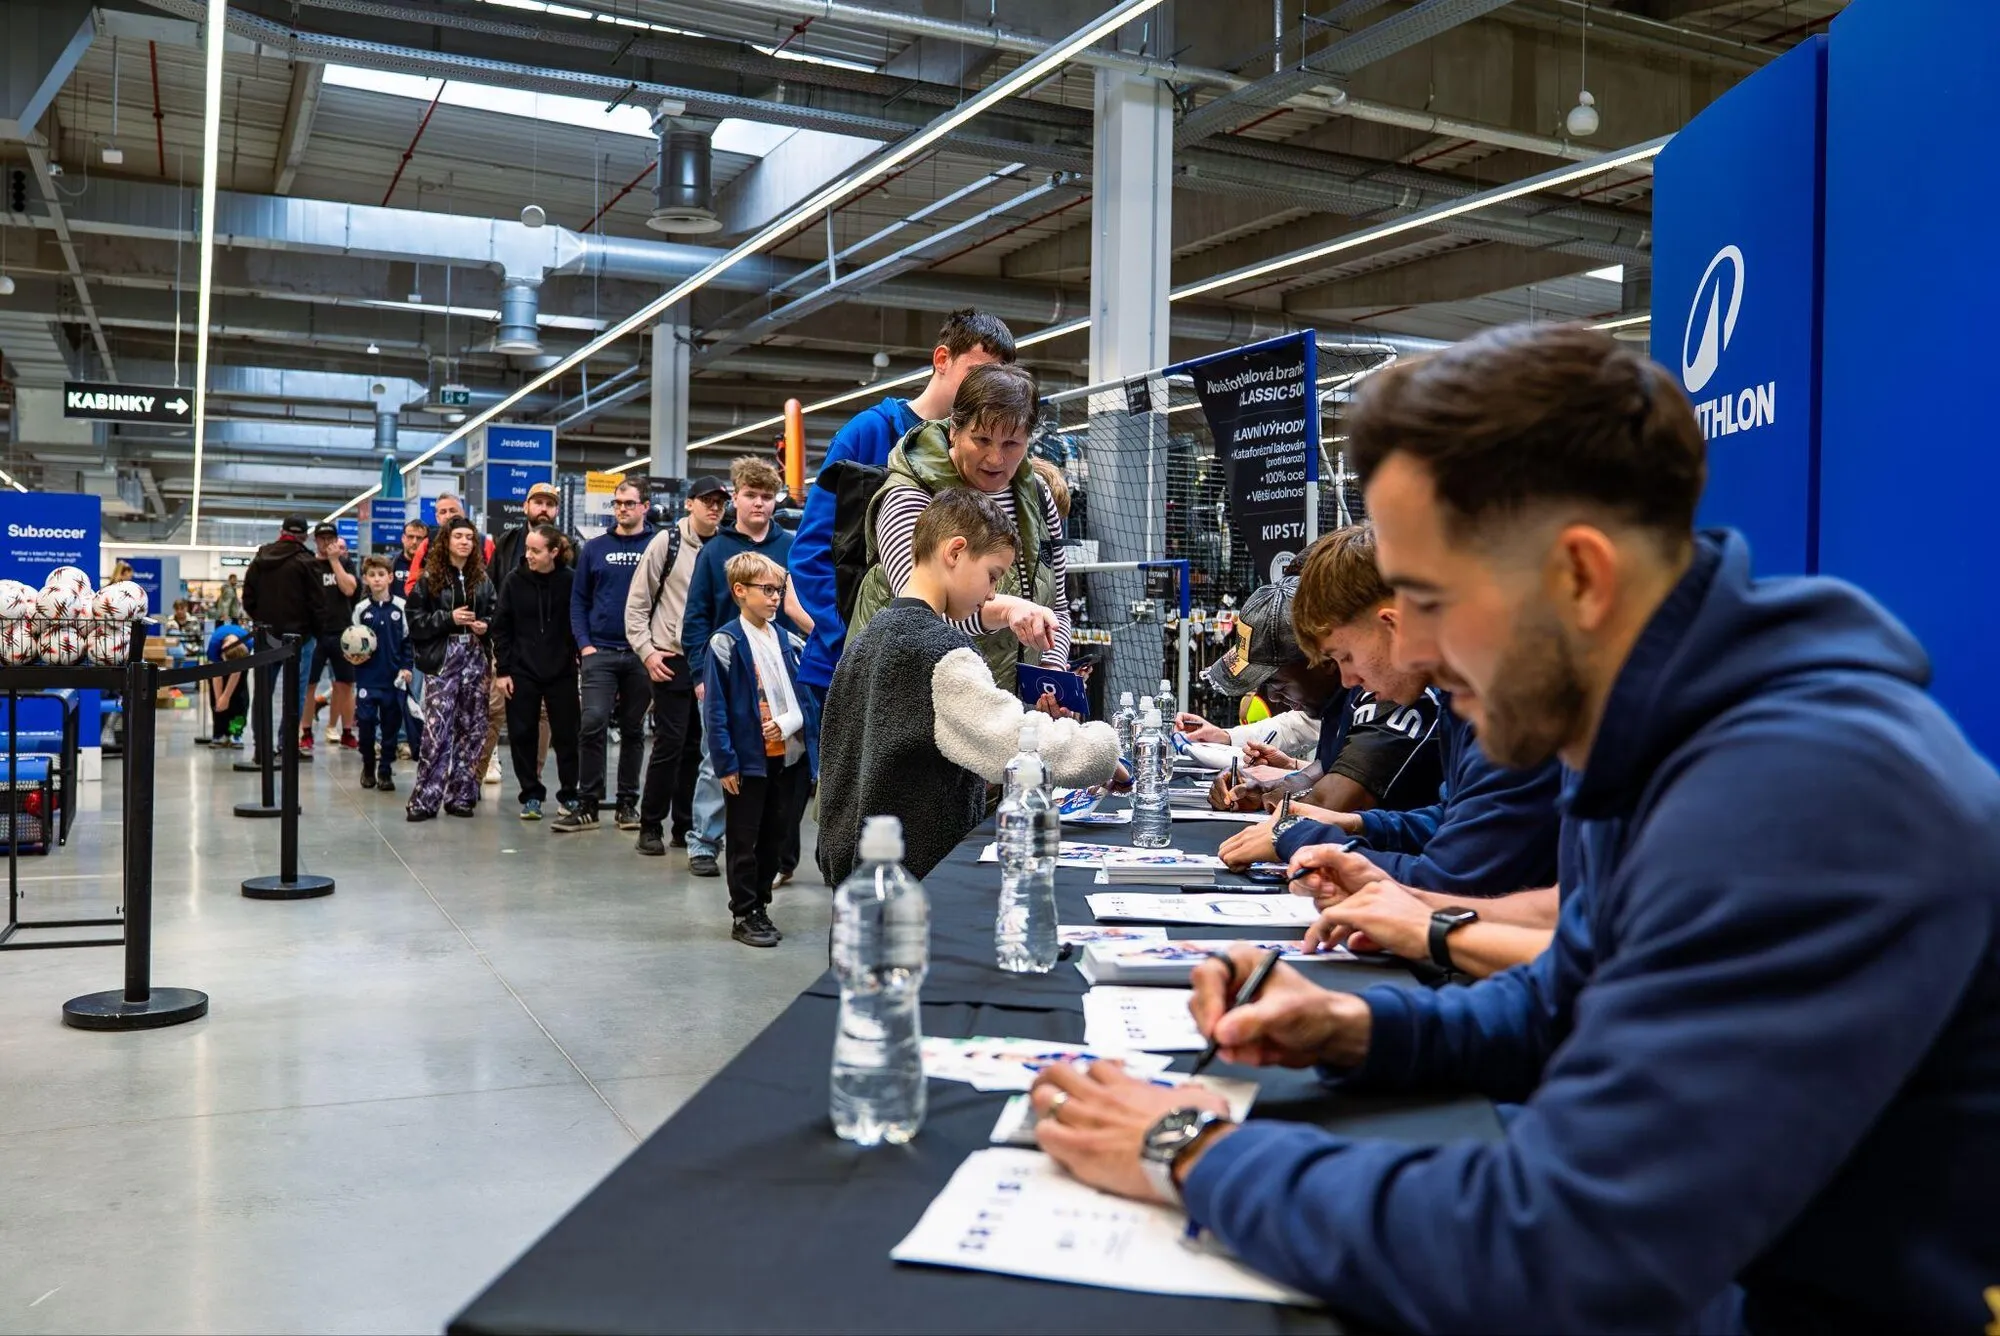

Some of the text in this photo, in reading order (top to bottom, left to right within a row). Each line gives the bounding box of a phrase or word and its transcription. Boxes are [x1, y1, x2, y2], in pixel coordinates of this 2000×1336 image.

[68, 391, 155, 412] KABINKY
[1262, 419, 1306, 436] VÝHODY
[1265, 468, 1306, 484] 100% oce
[8, 524, 86, 539] Subsoccer
